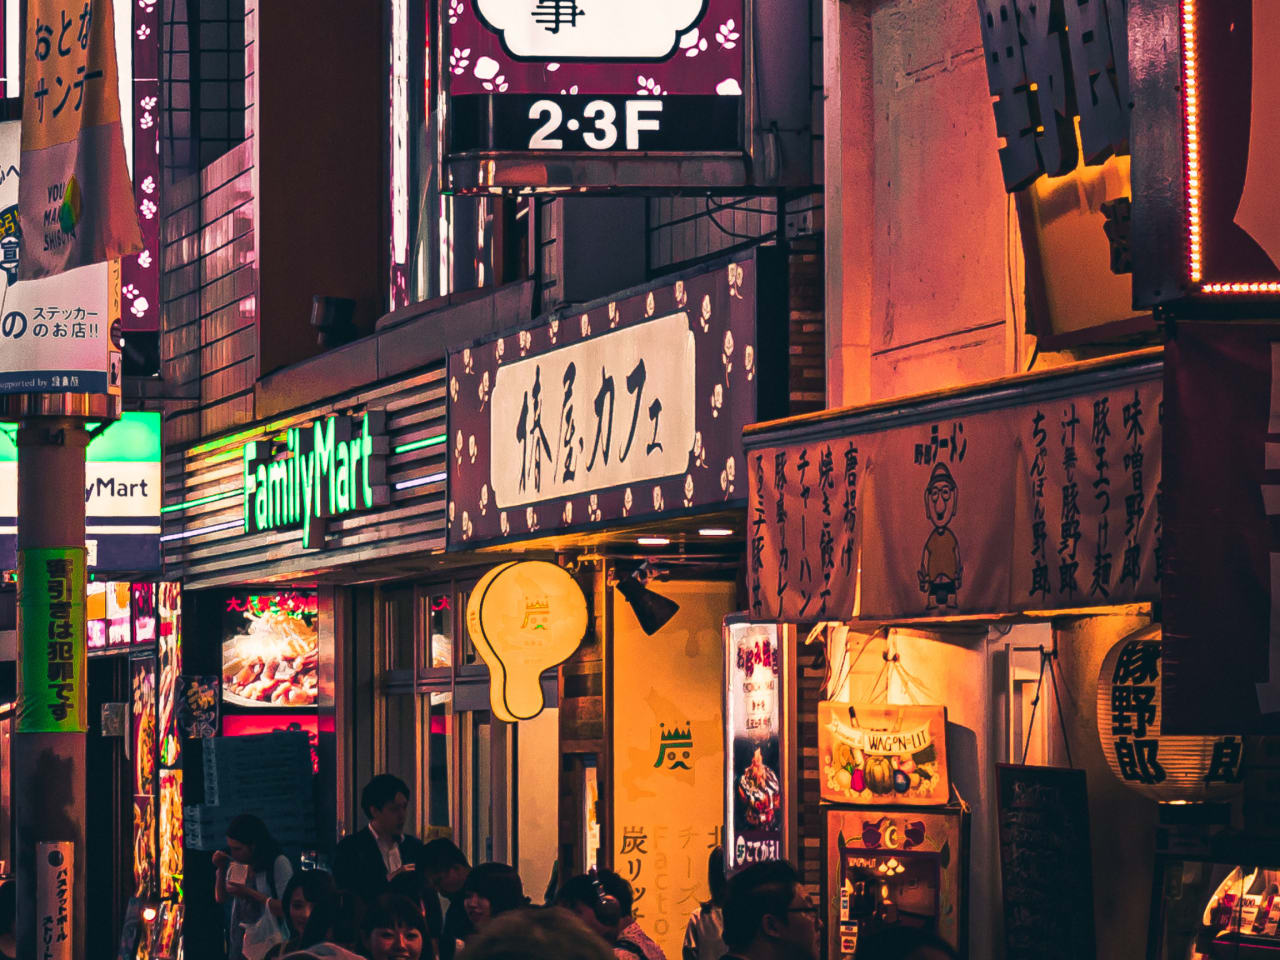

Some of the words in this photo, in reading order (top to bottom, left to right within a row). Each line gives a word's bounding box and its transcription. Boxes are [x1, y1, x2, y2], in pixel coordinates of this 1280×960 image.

[32, 307, 98, 321] ステッカー
[243, 411, 374, 549] FamilyMart
[515, 356, 664, 495] 椿屋カフェ
[796, 447, 812, 617] チャーハン
[46, 558, 75, 722] 客引きは犯罪です
[1111, 640, 1168, 785] 豚野郎
